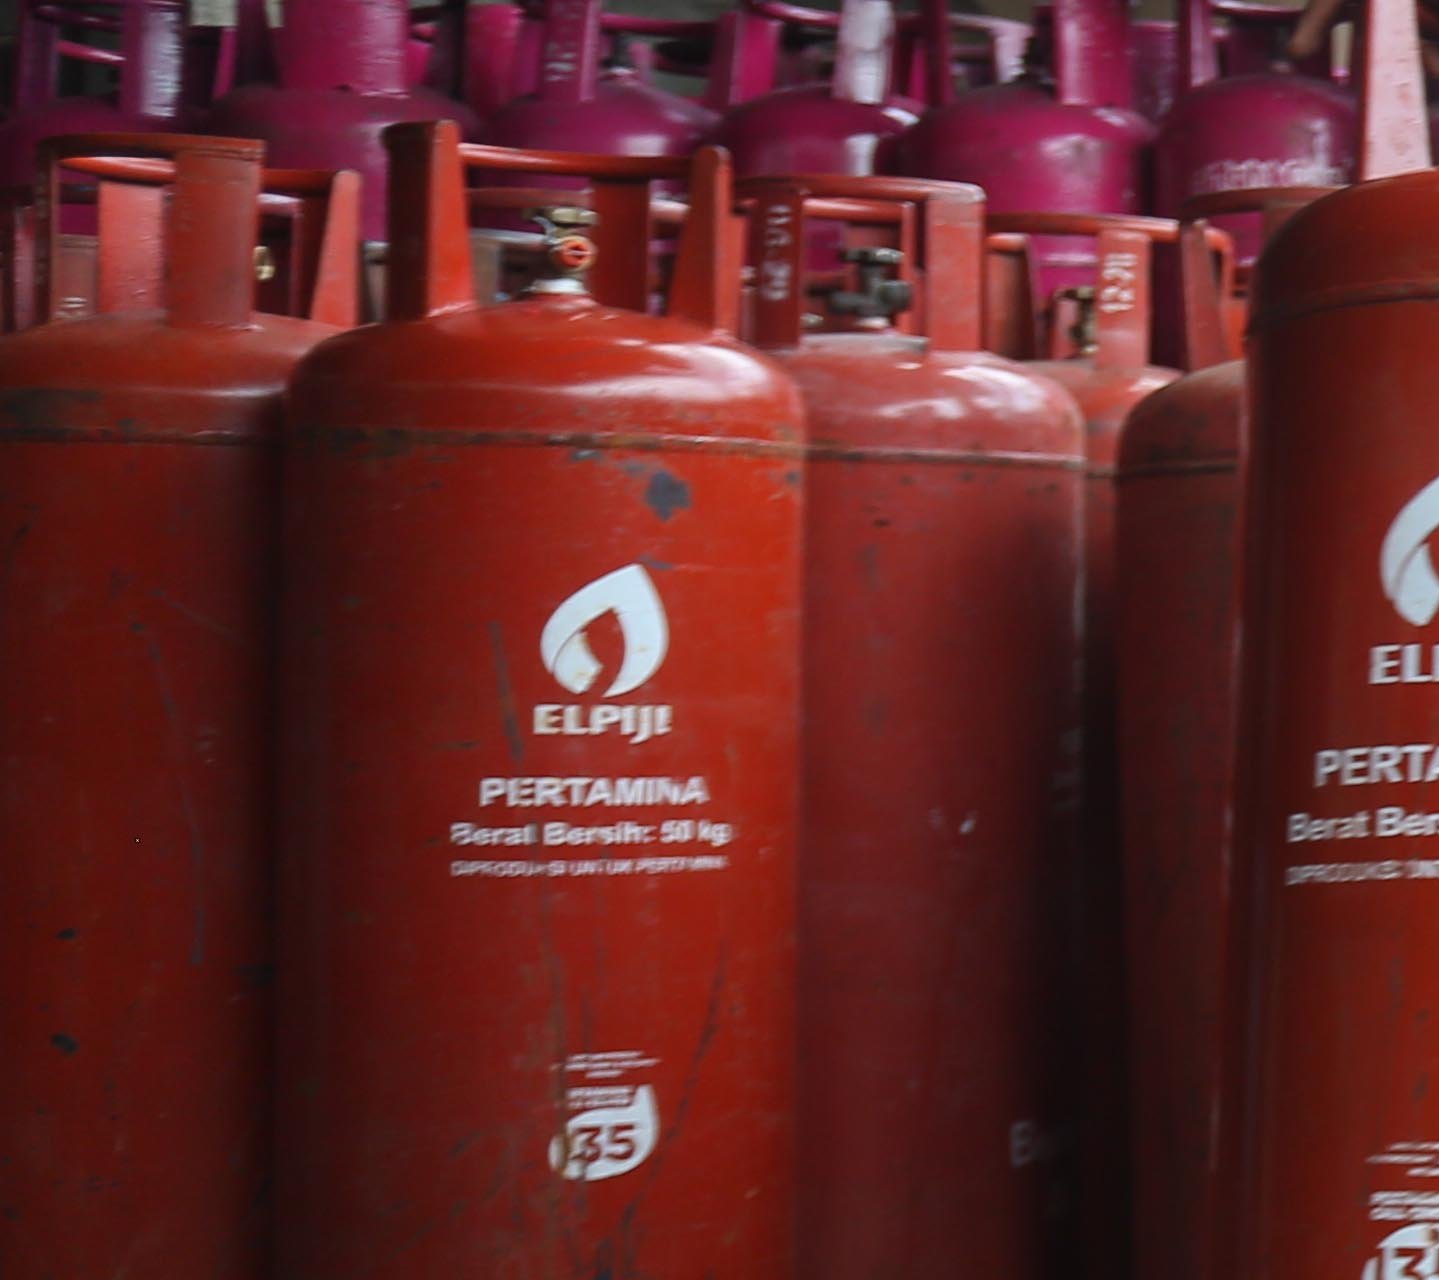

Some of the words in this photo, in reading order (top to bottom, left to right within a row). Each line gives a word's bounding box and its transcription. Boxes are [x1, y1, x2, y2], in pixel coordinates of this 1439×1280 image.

[533, 704, 673, 745] ELPIJI
[478, 776, 710, 808] PERTAMINA
[450, 822, 538, 847] Berat
[1286, 812, 1370, 843] Berat
